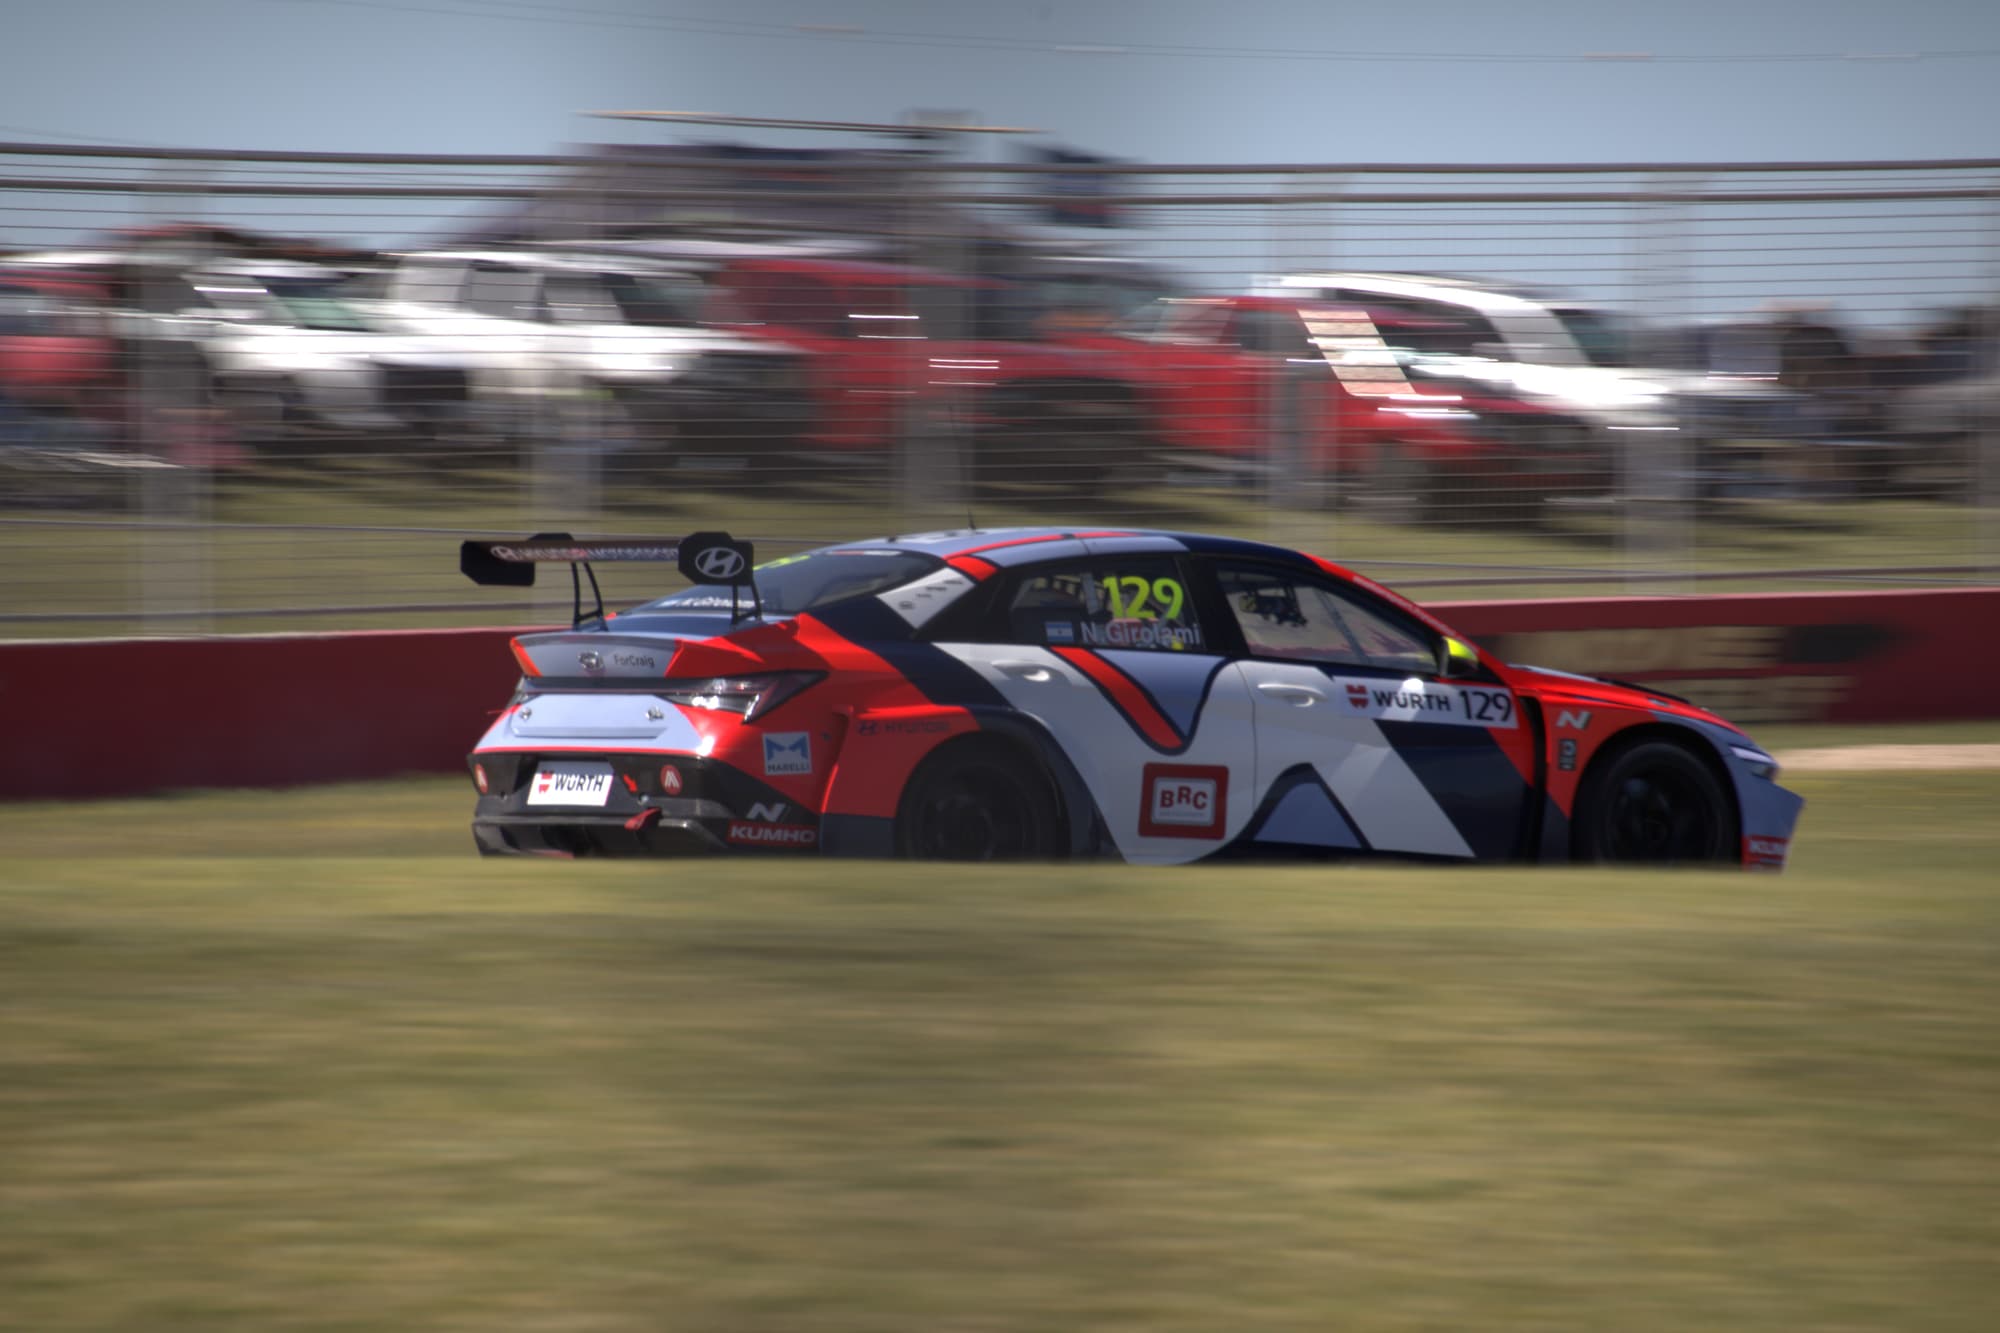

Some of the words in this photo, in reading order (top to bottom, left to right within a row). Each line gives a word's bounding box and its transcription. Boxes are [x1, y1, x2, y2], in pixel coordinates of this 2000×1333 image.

[1103, 575, 1184, 620] 129
[1373, 690, 1453, 712] WÜRTH
[1459, 690, 1512, 722] 129
[767, 761, 810, 773] MARELLI
[1159, 785, 1208, 810] BRC
[729, 825, 816, 843] KUMHO
